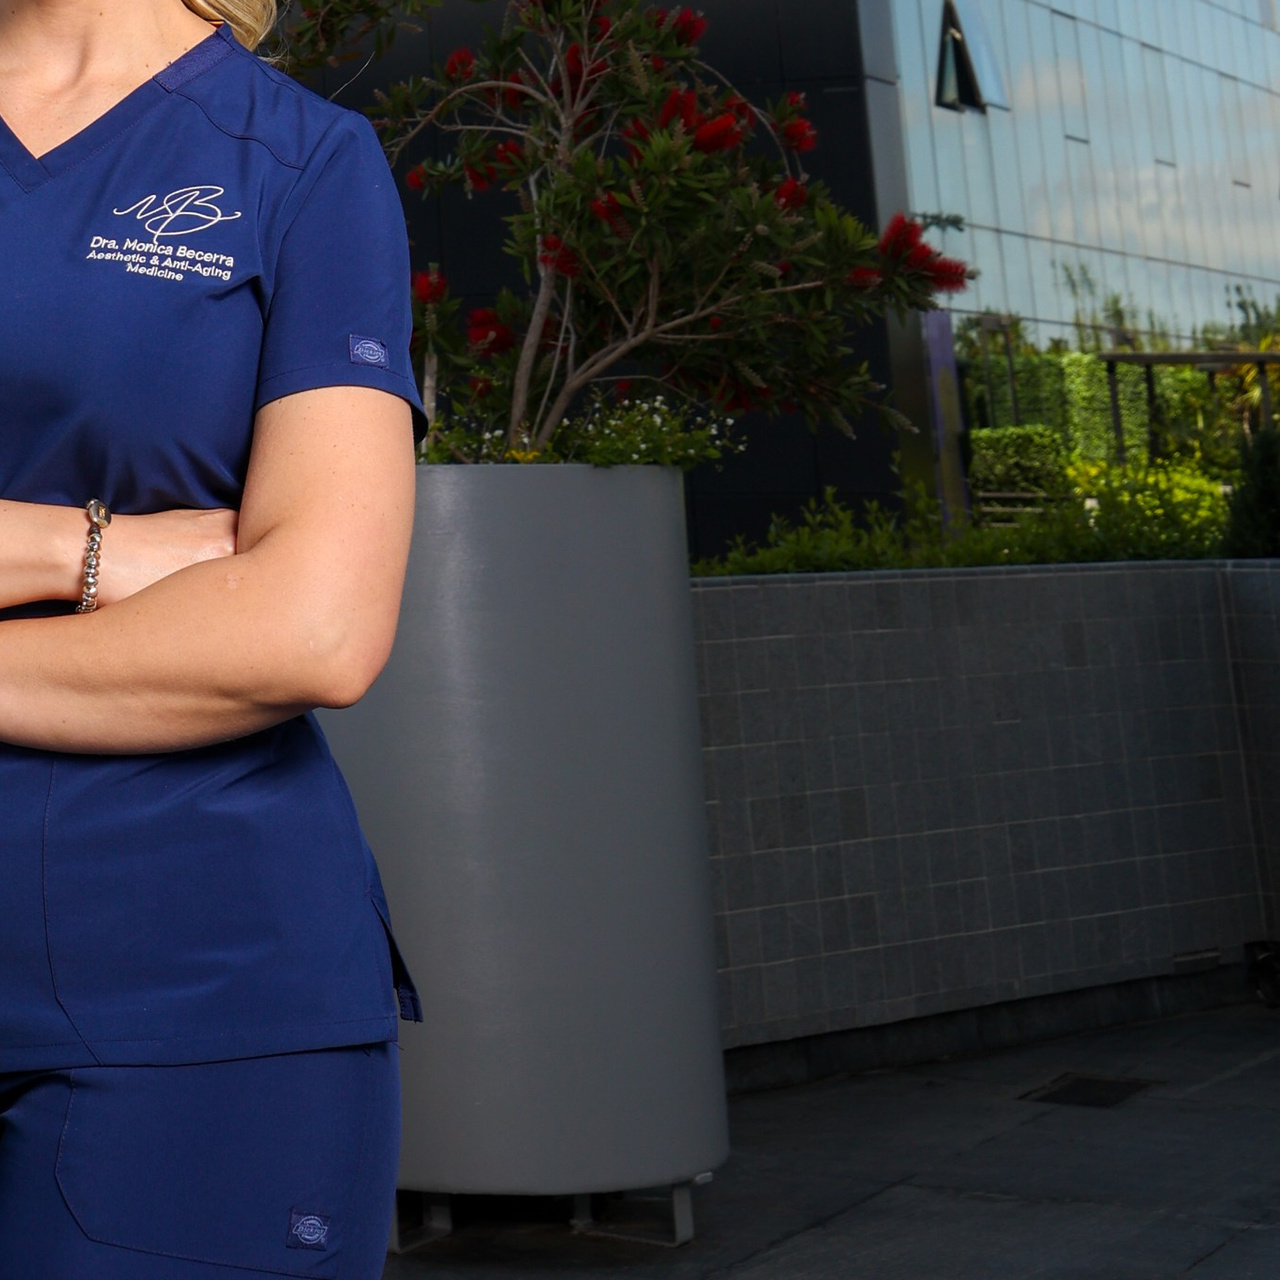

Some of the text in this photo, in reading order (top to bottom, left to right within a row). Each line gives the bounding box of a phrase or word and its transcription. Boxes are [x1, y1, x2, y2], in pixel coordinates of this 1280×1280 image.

[85, 249, 232, 281] Aesthetic & Anti-Aging
[89, 235, 119, 250] Dra.
[175, 245, 235, 268] Becerra
[125, 261, 184, 282] Medicine
